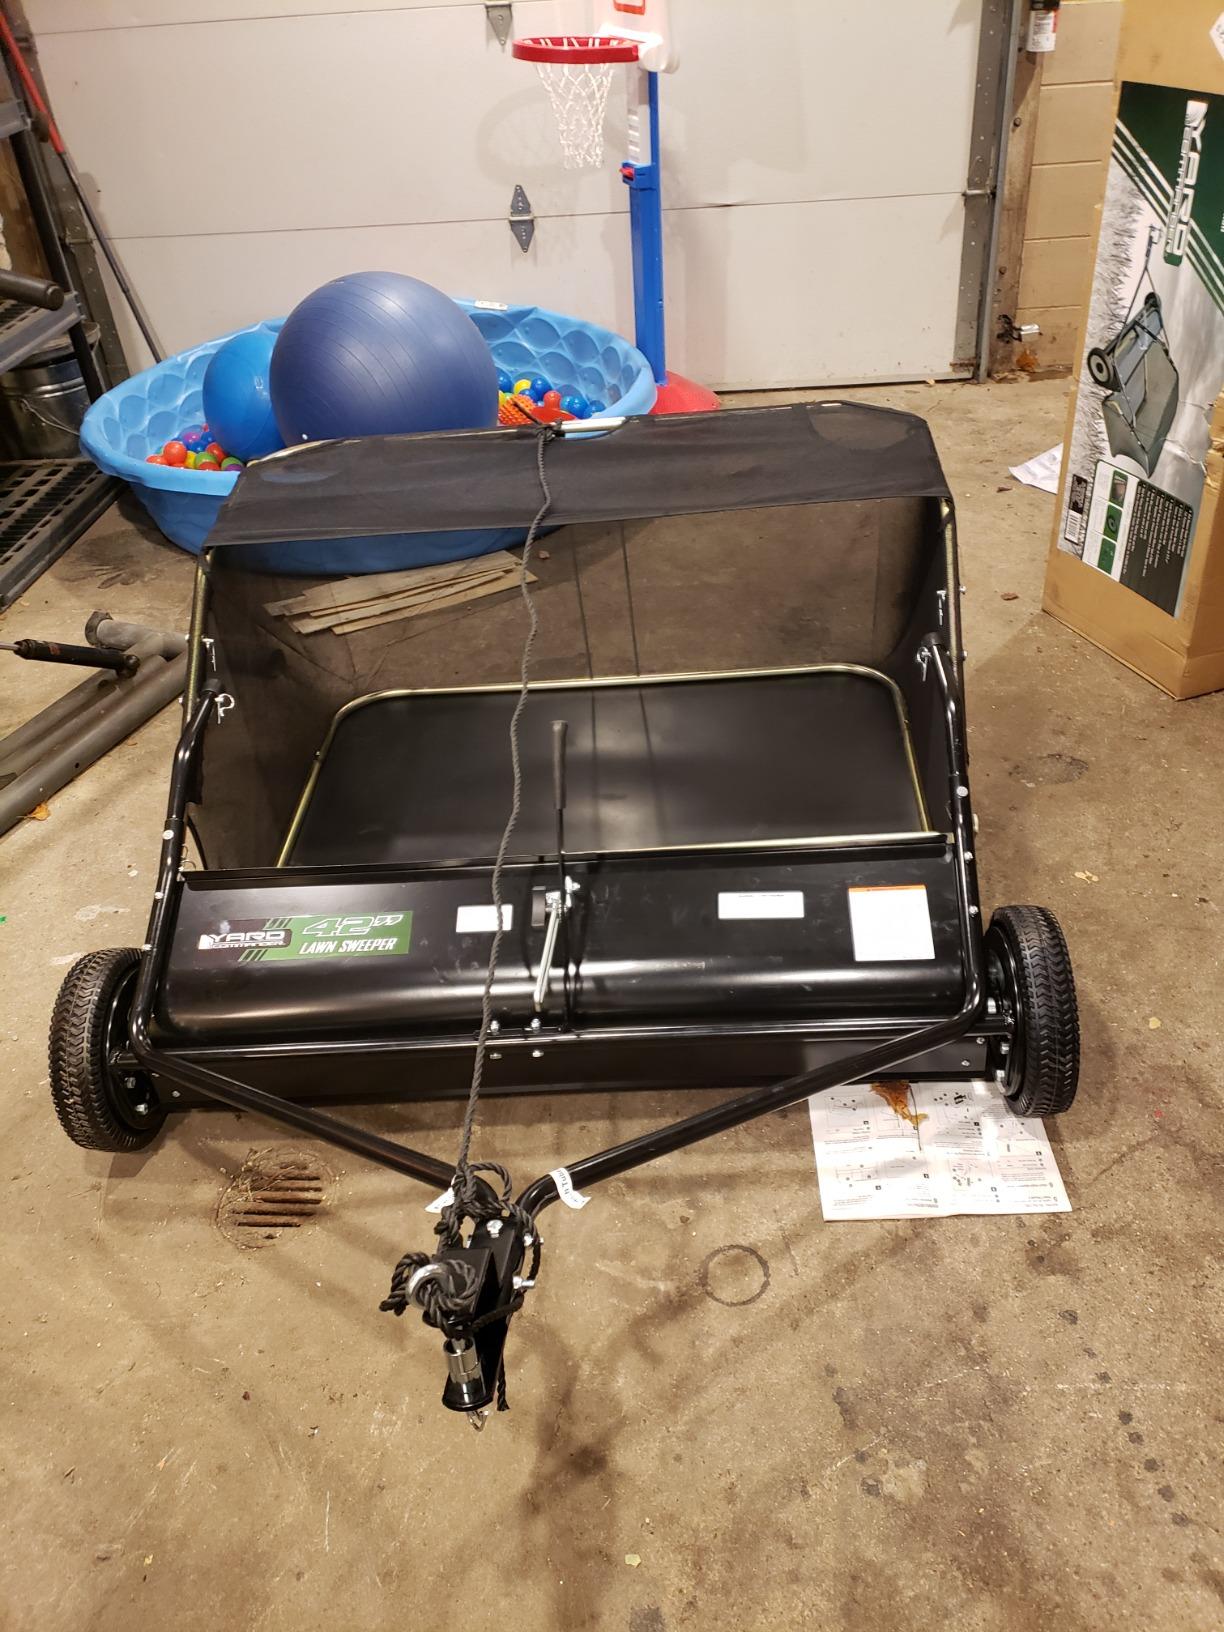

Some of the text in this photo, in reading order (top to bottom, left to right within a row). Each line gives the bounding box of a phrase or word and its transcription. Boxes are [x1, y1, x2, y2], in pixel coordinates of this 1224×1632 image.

[1172, 117, 1207, 256] YARD
[212, 930, 286, 942] YARD
[299, 937, 398, 955] LAWN SWEEPER
